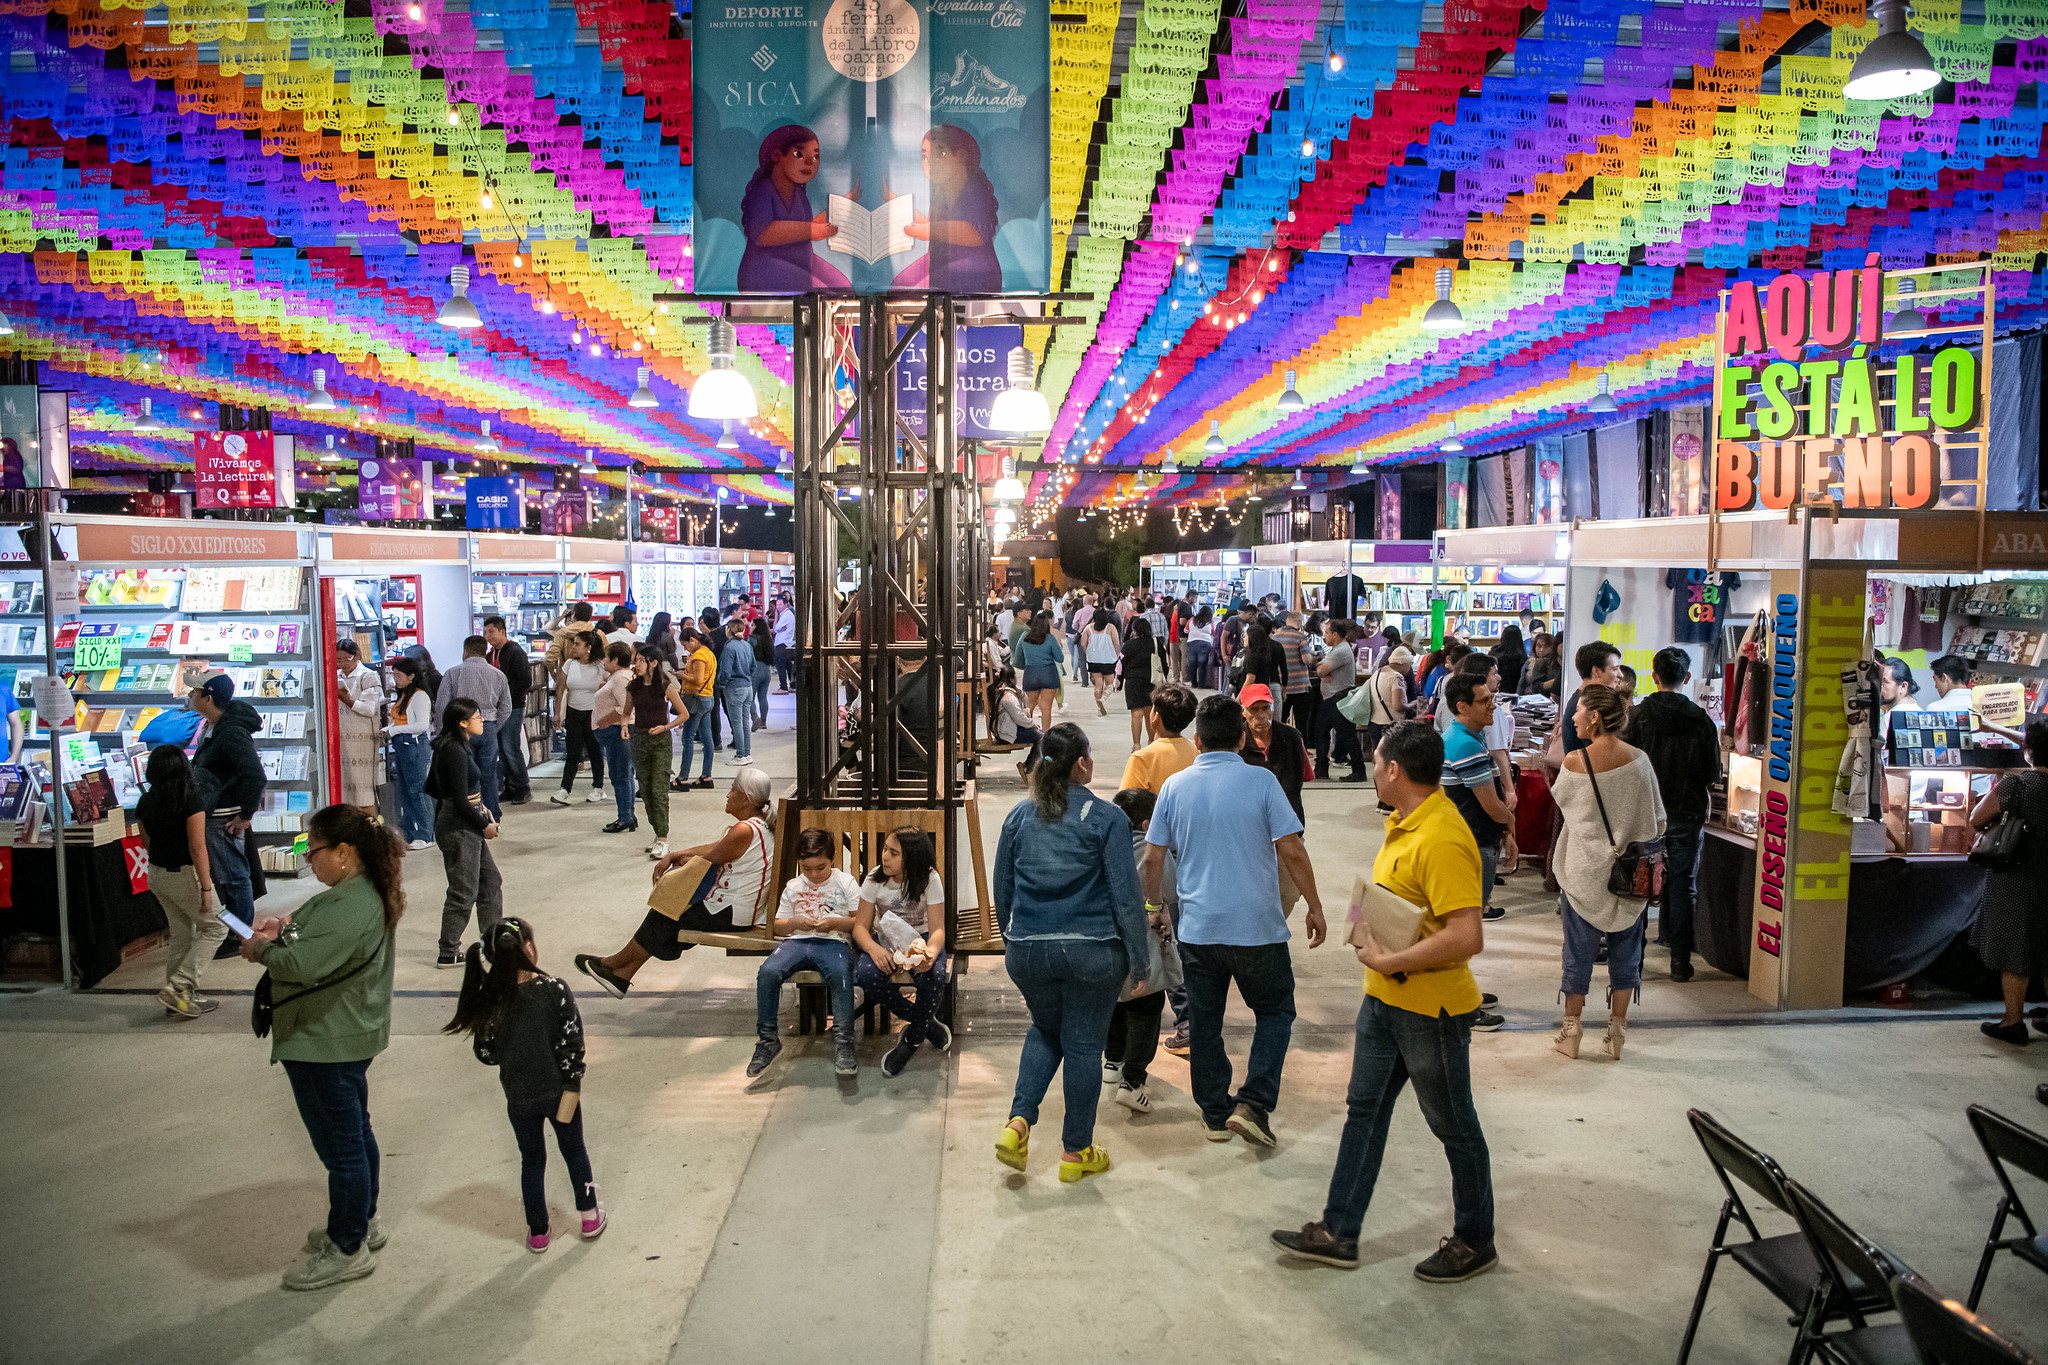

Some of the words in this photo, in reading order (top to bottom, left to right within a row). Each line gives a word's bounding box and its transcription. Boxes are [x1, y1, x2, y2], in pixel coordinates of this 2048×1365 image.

[725, 7, 803, 19] DEPORTE
[926, 0, 994, 15] Levadura
[999, 0, 1014, 11] de
[841, 10, 895, 25] feria
[990, 11, 1023, 28] Olla
[828, 25, 916, 35] internacional
[829, 38, 854, 51] del
[860, 35, 916, 51] libro
[830, 52, 842, 61] de
[843, 52, 906, 64] oaxaca
[849, 65, 882, 77] 2023
[725, 81, 802, 107] SICA
[926, 85, 1027, 109] Combinados
[1723, 251, 1884, 361] AQUÍ
[1721, 344, 1882, 441] ESTÁ
[1895, 347, 1981, 438] LO
[208, 457, 262, 469] ¡Vivamos
[201, 471, 215, 482] la
[218, 471, 271, 482] lectura!
[1717, 434, 1940, 511] BUENO
[476, 495, 508, 503] CASIO
[131, 535, 176, 554] SIGLO
[177, 536, 203, 554] XXI
[205, 536, 266, 554] EDITORES
[370, 543, 409, 555] EDICIONES
[1688, 585, 1720, 604] xa
[1688, 603, 1716, 622] ca
[79, 637, 102, 646] SIGLO
[105, 636, 121, 644] XXI
[76, 647, 109, 667] 10%
[1769, 593, 1799, 783] OAXAQUEÑO
[1761, 790, 1788, 913] DISEÑO
[1794, 851, 1850, 900] EL
[1757, 921, 1782, 958] EL
